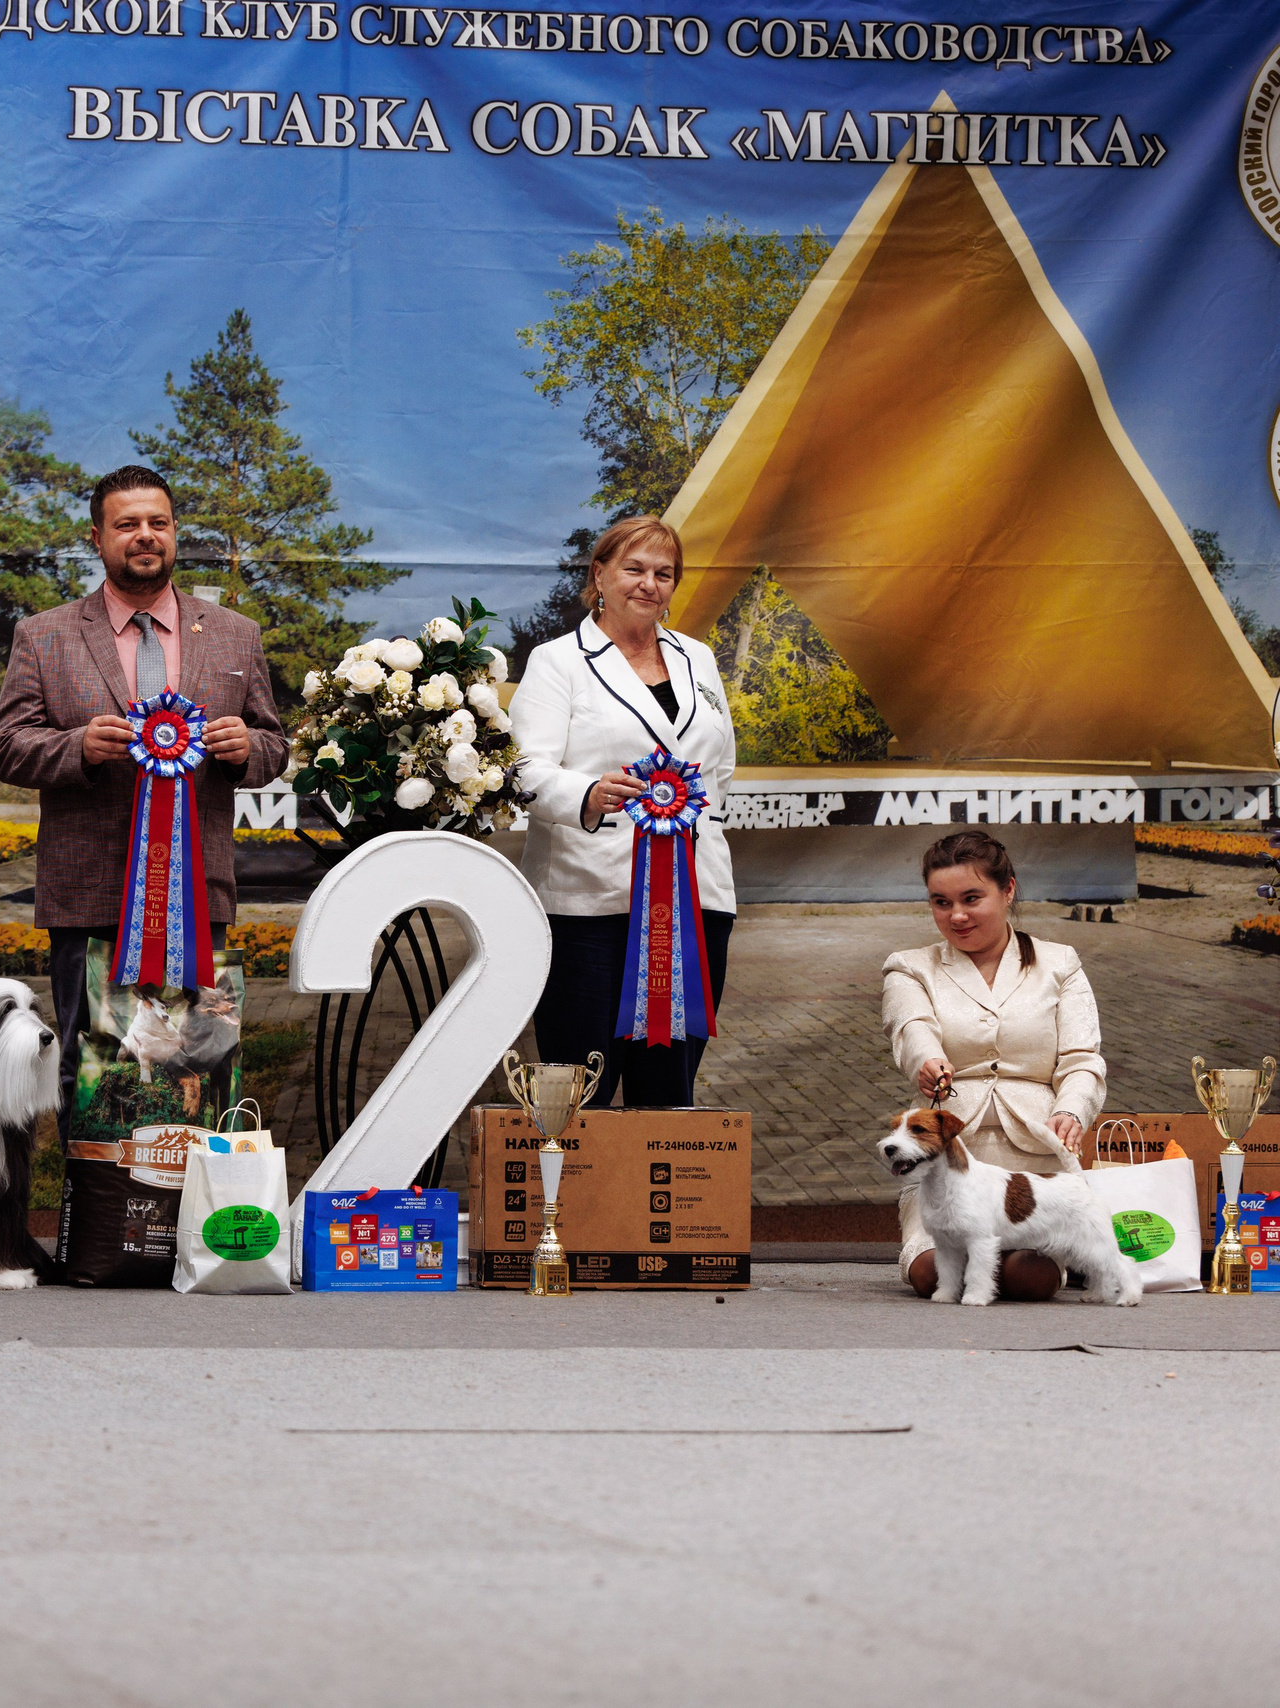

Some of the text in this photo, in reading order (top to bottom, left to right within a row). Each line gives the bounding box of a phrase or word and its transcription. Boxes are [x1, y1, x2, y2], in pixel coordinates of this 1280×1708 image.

[200, 0, 339, 42] КЛУБ
[350, 5, 710, 57] СЛУЖЕБНОГО
[726, 17, 1173, 71] СОБАКОВОДСТВА»
[68, 85, 1168, 168] ВЫСТАВКА СОБАК «МАГНИТКА»
[1244, 129, 1280, 236] ГОРСКИЙ
[1160, 786, 1271, 822] ГОРЫ
[505, 1138, 580, 1150] HARNS
[647, 1140, 738, 1152] HT-24H06B-VZ/M
[1098, 1141, 1165, 1153] HARTENS
[135, 1147, 187, 1165] BREEDER'
[507, 1164, 524, 1172] LED
[510, 1172, 522, 1180] TV
[336, 1199, 357, 1207] AVZ
[1245, 1200, 1265, 1209] AVZ
[508, 1223, 524, 1232] HD
[576, 1256, 610, 1268] LED
[638, 1256, 663, 1272] USB
[692, 1257, 736, 1266] HDMI
